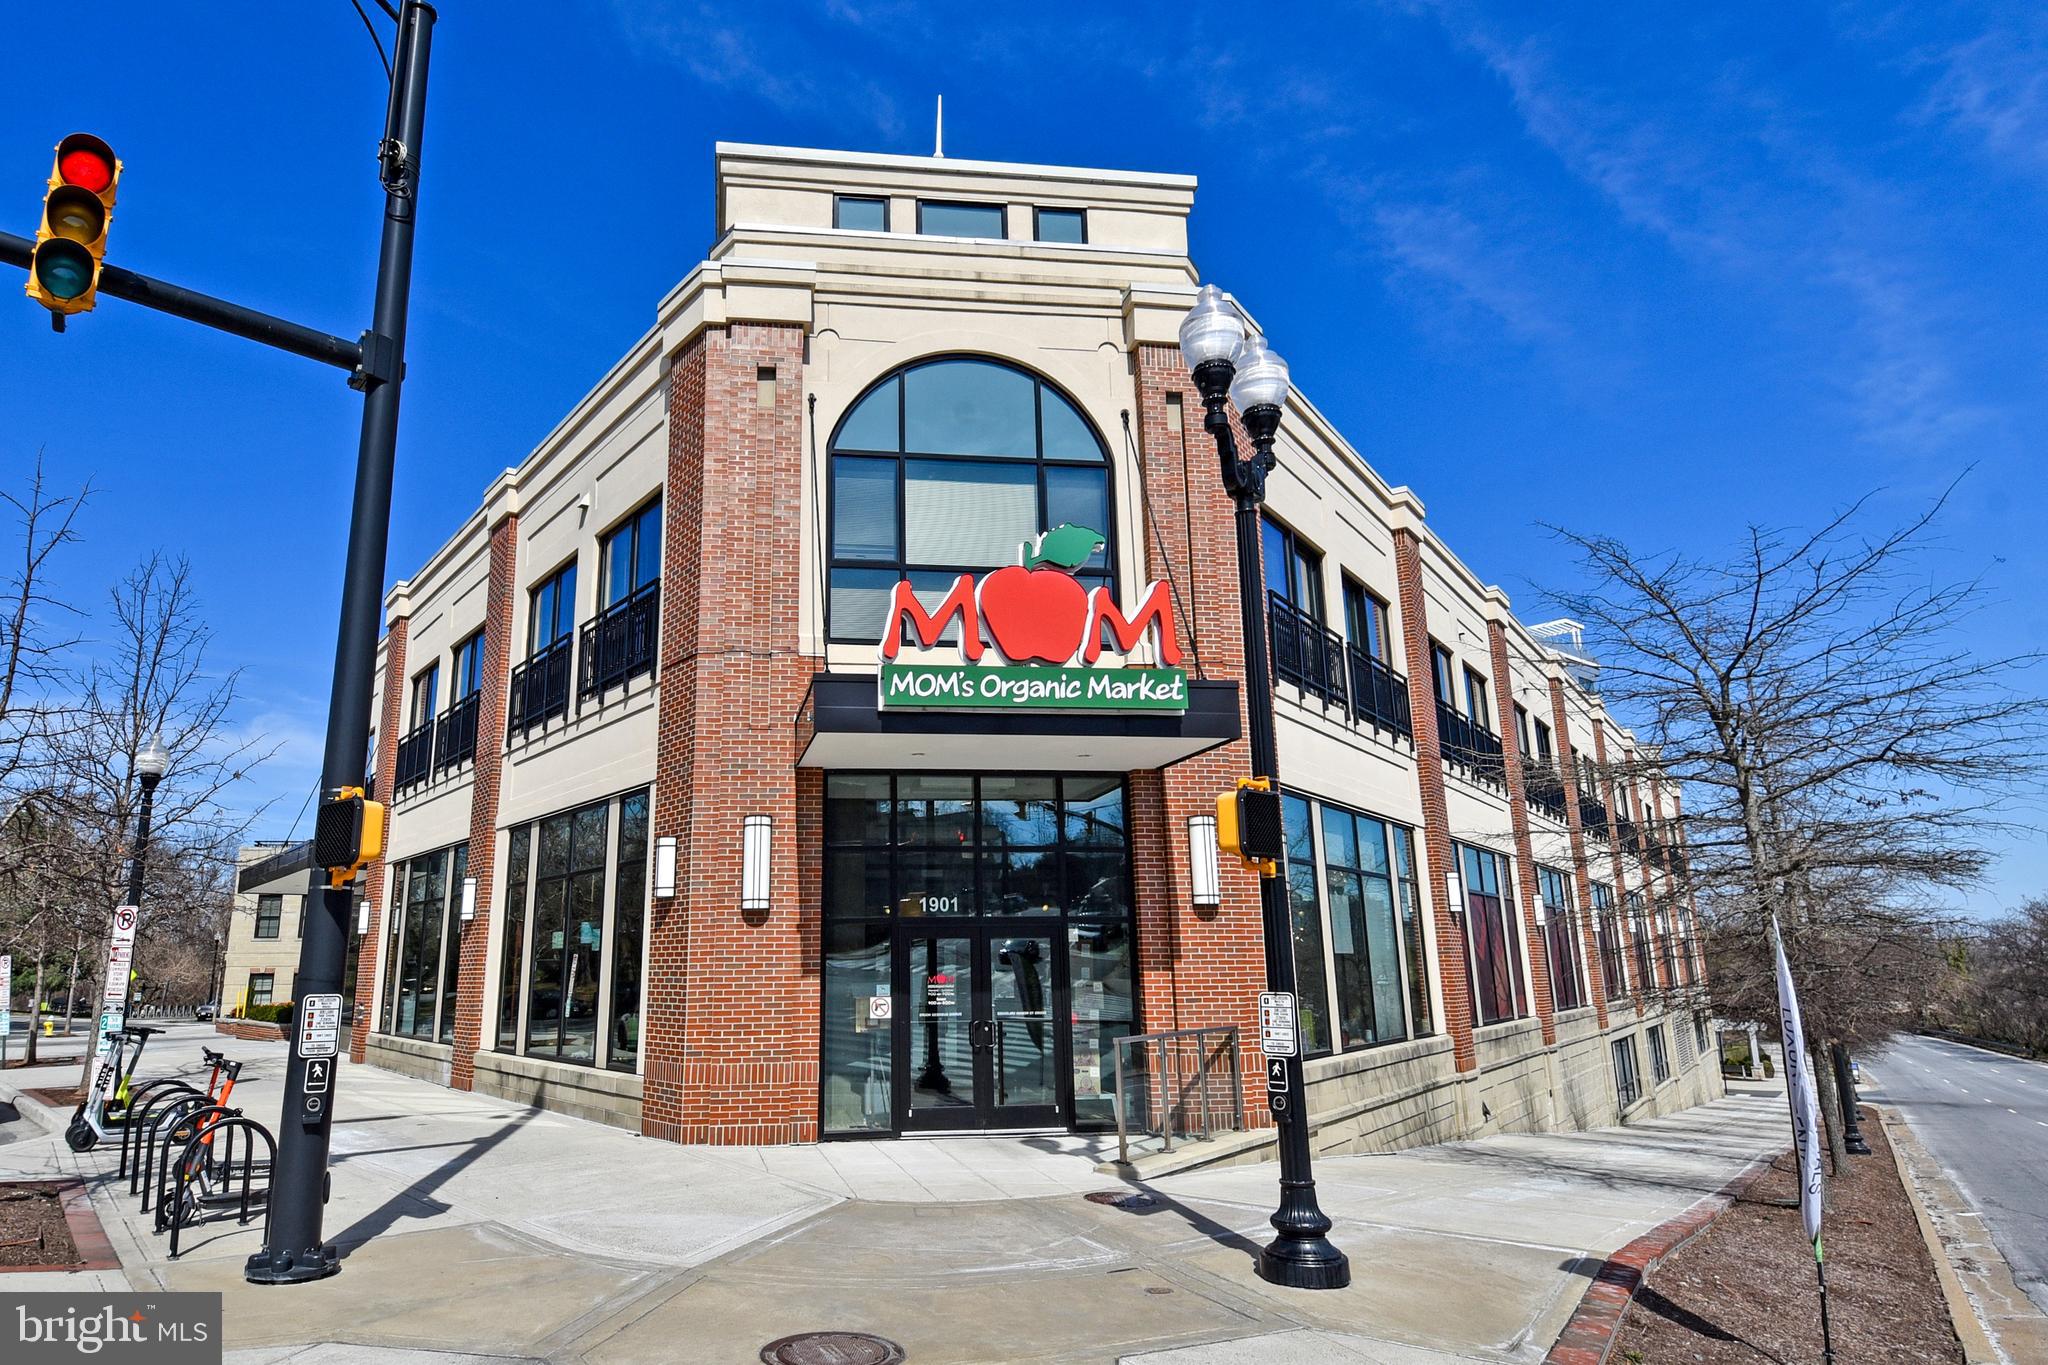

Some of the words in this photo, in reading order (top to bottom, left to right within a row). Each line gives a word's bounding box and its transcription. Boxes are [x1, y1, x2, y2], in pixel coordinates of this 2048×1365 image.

[890, 671, 974, 697] MOM's
[980, 674, 1082, 703] Organic
[1087, 673, 1184, 700] Market
[919, 896, 958, 912] 1901
[101, 1016, 108, 1028] 2
[1782, 1007, 1797, 1087] LUXU
